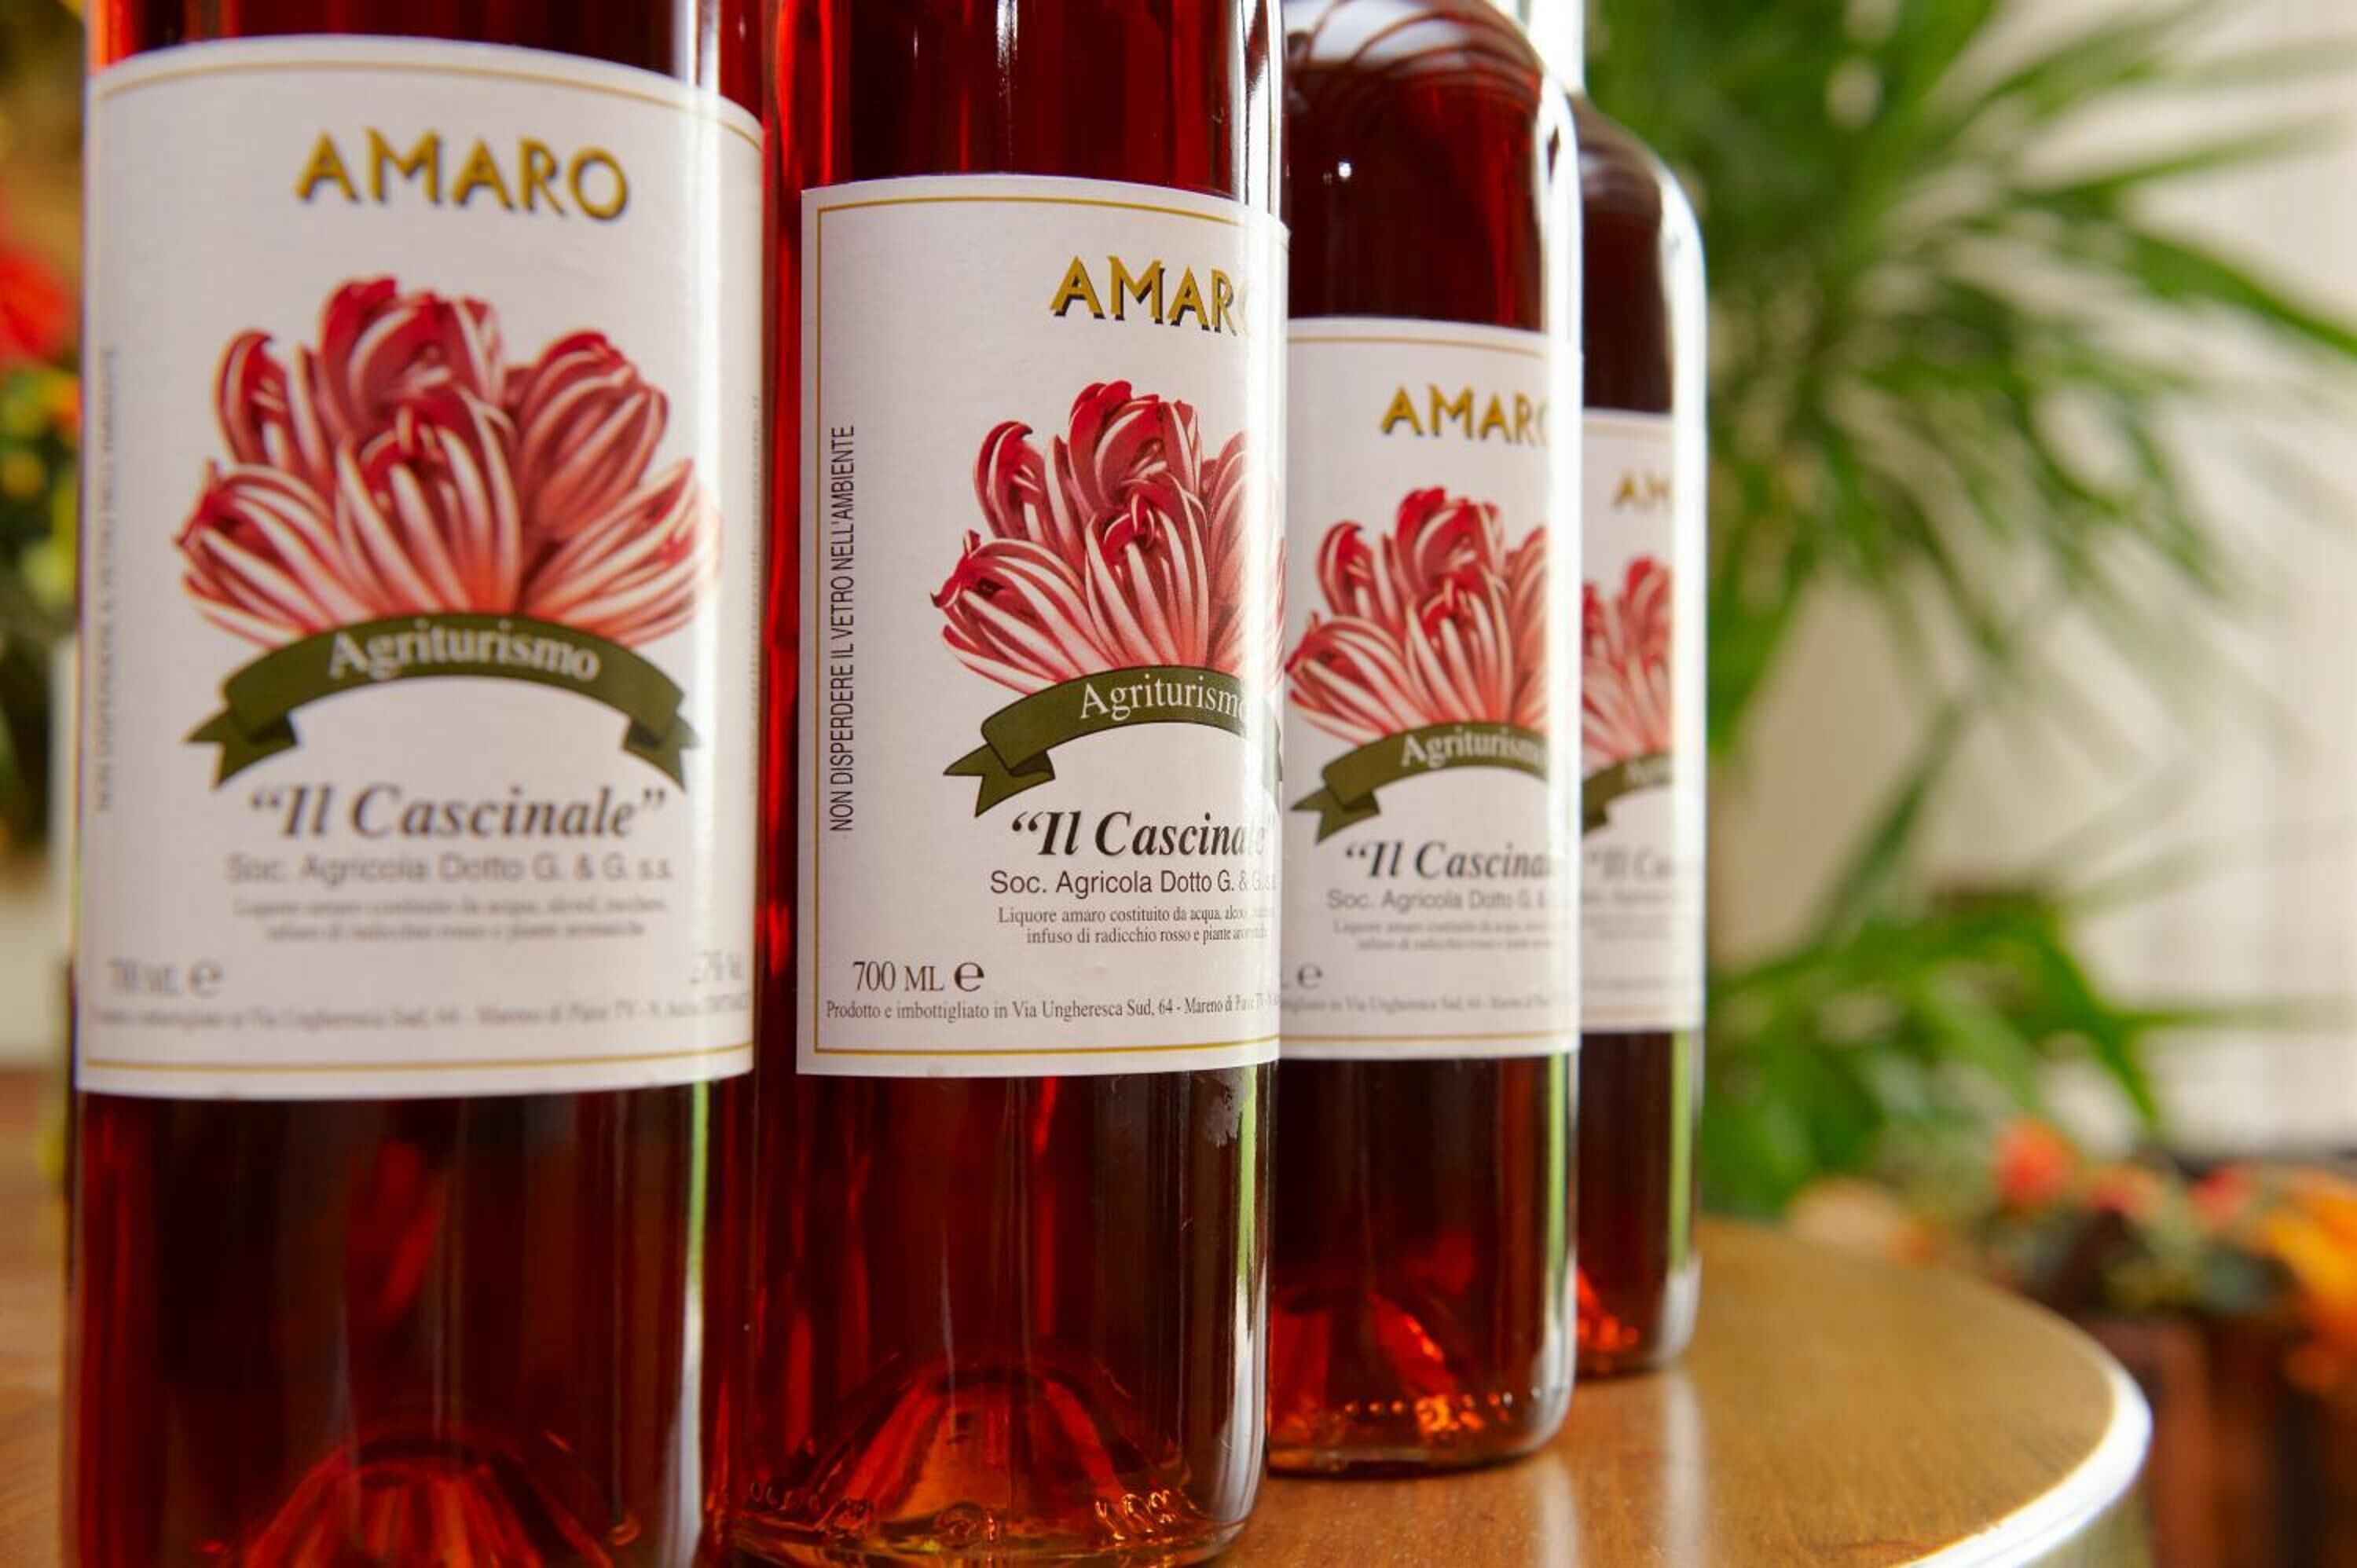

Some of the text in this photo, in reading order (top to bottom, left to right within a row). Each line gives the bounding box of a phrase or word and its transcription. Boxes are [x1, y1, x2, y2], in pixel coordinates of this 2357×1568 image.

[295, 126, 629, 222] AMARO
[830, 425, 854, 831] NON DISPERDERE IL VETRO NELL'AMBIENTE
[329, 617, 601, 683] Agriturismo
[299, 853, 428, 891] Agricola
[438, 852, 526, 883] Dotto
[990, 870, 1047, 894] Soc.
[1056, 870, 1152, 899] Agricola
[1160, 870, 1211, 892] Dotto
[1217, 869, 1234, 892] G.
[998, 907, 1058, 927] Liquore
[1062, 910, 1105, 923] amaro
[1110, 906, 1169, 923] costituito
[1173, 906, 1187, 921] da
[1381, 889, 1464, 914] Agricola
[1027, 929, 1073, 944] infuso
[1077, 927, 1090, 943] di
[1095, 926, 1157, 943] radicchio
[1160, 929, 1191, 942] rosso
[1193, 930, 1200, 941] e
[1203, 925, 1231, 945] piante
[852, 961, 896, 991] 700
[904, 965, 944, 991] ML
[827, 1000, 881, 1018] Prodotto
[884, 1005, 893, 1019] e
[896, 1001, 989, 1023] imbottigliato
[994, 1002, 1008, 1018] in
[1011, 1001, 1037, 1018] Via
[1043, 998, 1123, 1022] Ungheresca
[1158, 998, 1173, 1015] 64
[1184, 997, 1223, 1015] Mareno
